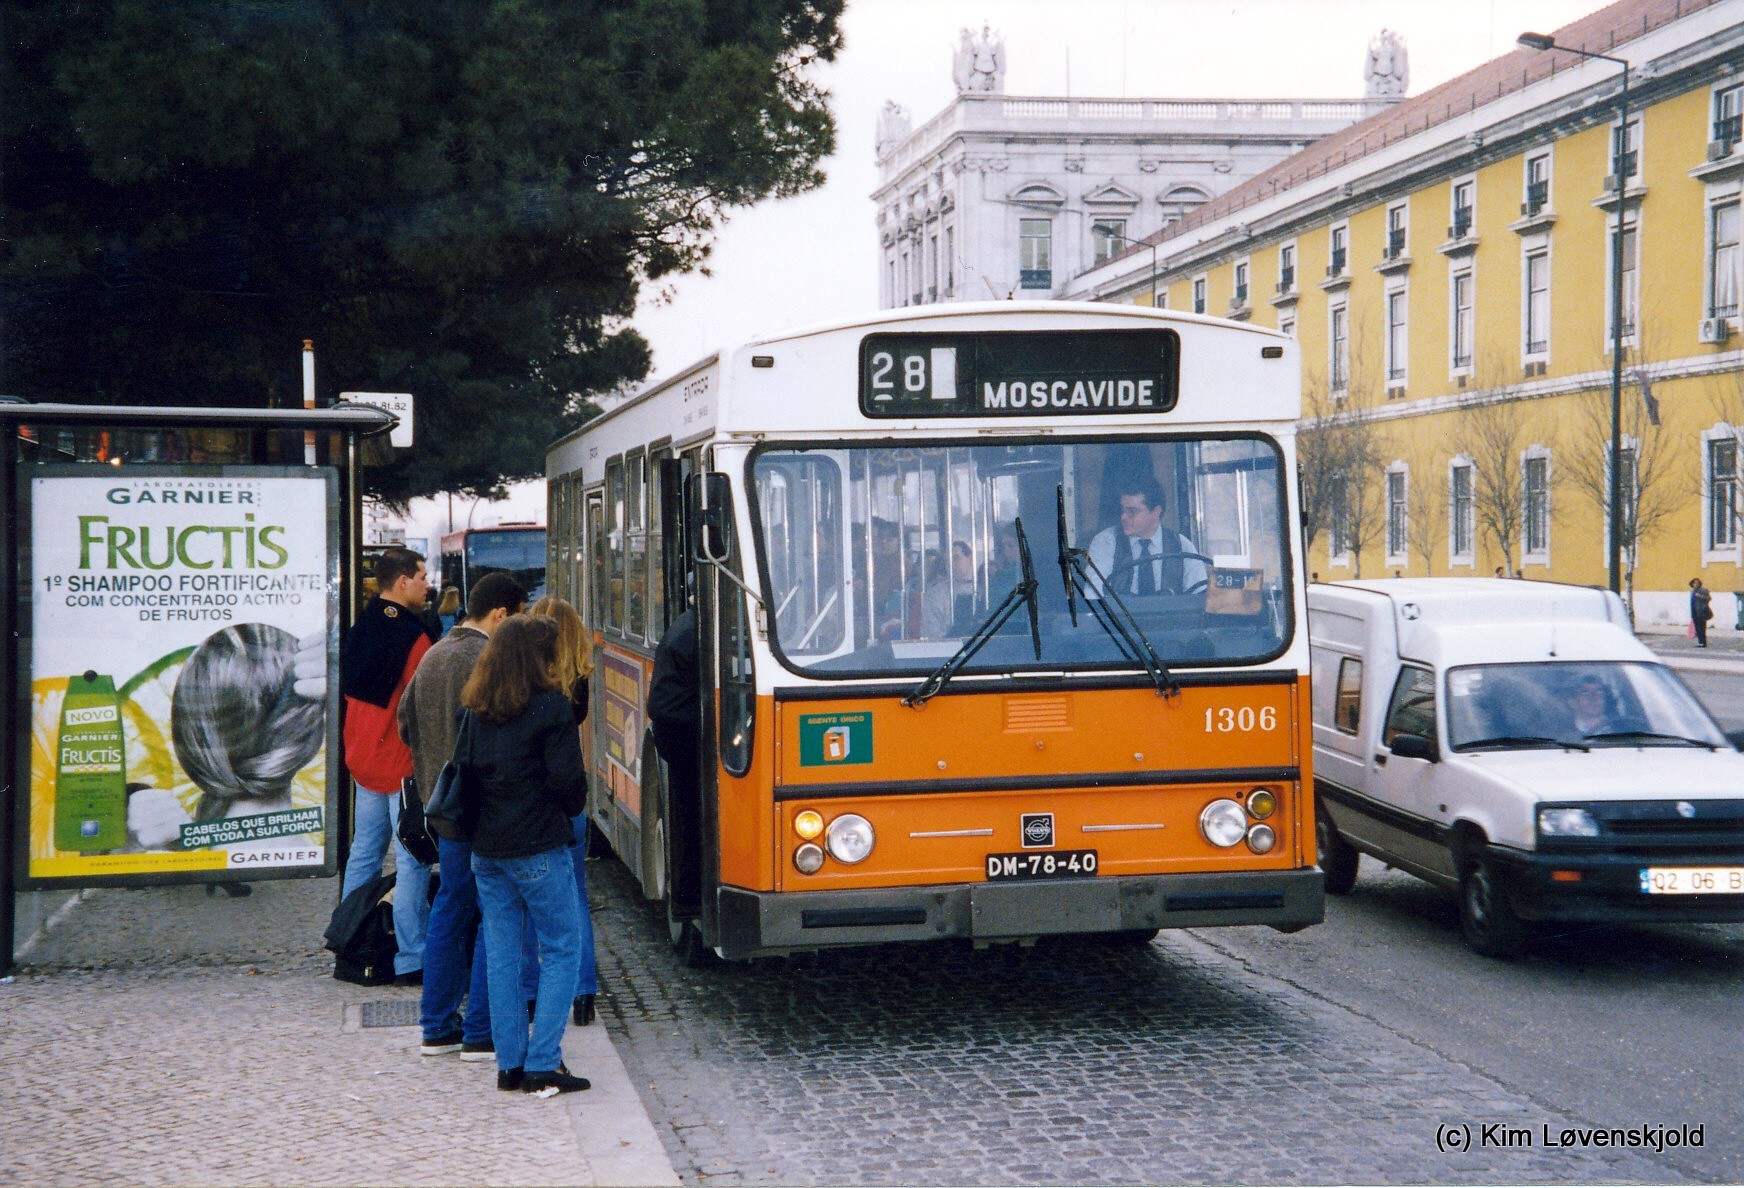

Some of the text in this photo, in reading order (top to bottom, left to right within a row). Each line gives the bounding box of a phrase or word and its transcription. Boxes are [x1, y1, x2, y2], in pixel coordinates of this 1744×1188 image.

[872, 352, 926, 392] 28
[984, 380, 1154, 408] MOSCAVIDE
[106, 487, 254, 505] GARNIER
[68, 575, 173, 593] SHAMPOO
[180, 574, 321, 592] FORTIFICANTE
[65, 593, 302, 608] COM CONCENTRADO ACTIVO
[139, 608, 233, 621] DE FRUTOS
[69, 709, 114, 722] NOVO
[1205, 705, 1277, 732] 1306
[61, 734, 118, 743] GARNIER
[183, 809, 318, 837] CABELOS QUE BRILHAM
[183, 820, 321, 847] COM TODA A SUA FORÇA
[231, 851, 318, 864] GARNIER
[988, 853, 1096, 877] DM-78-40
